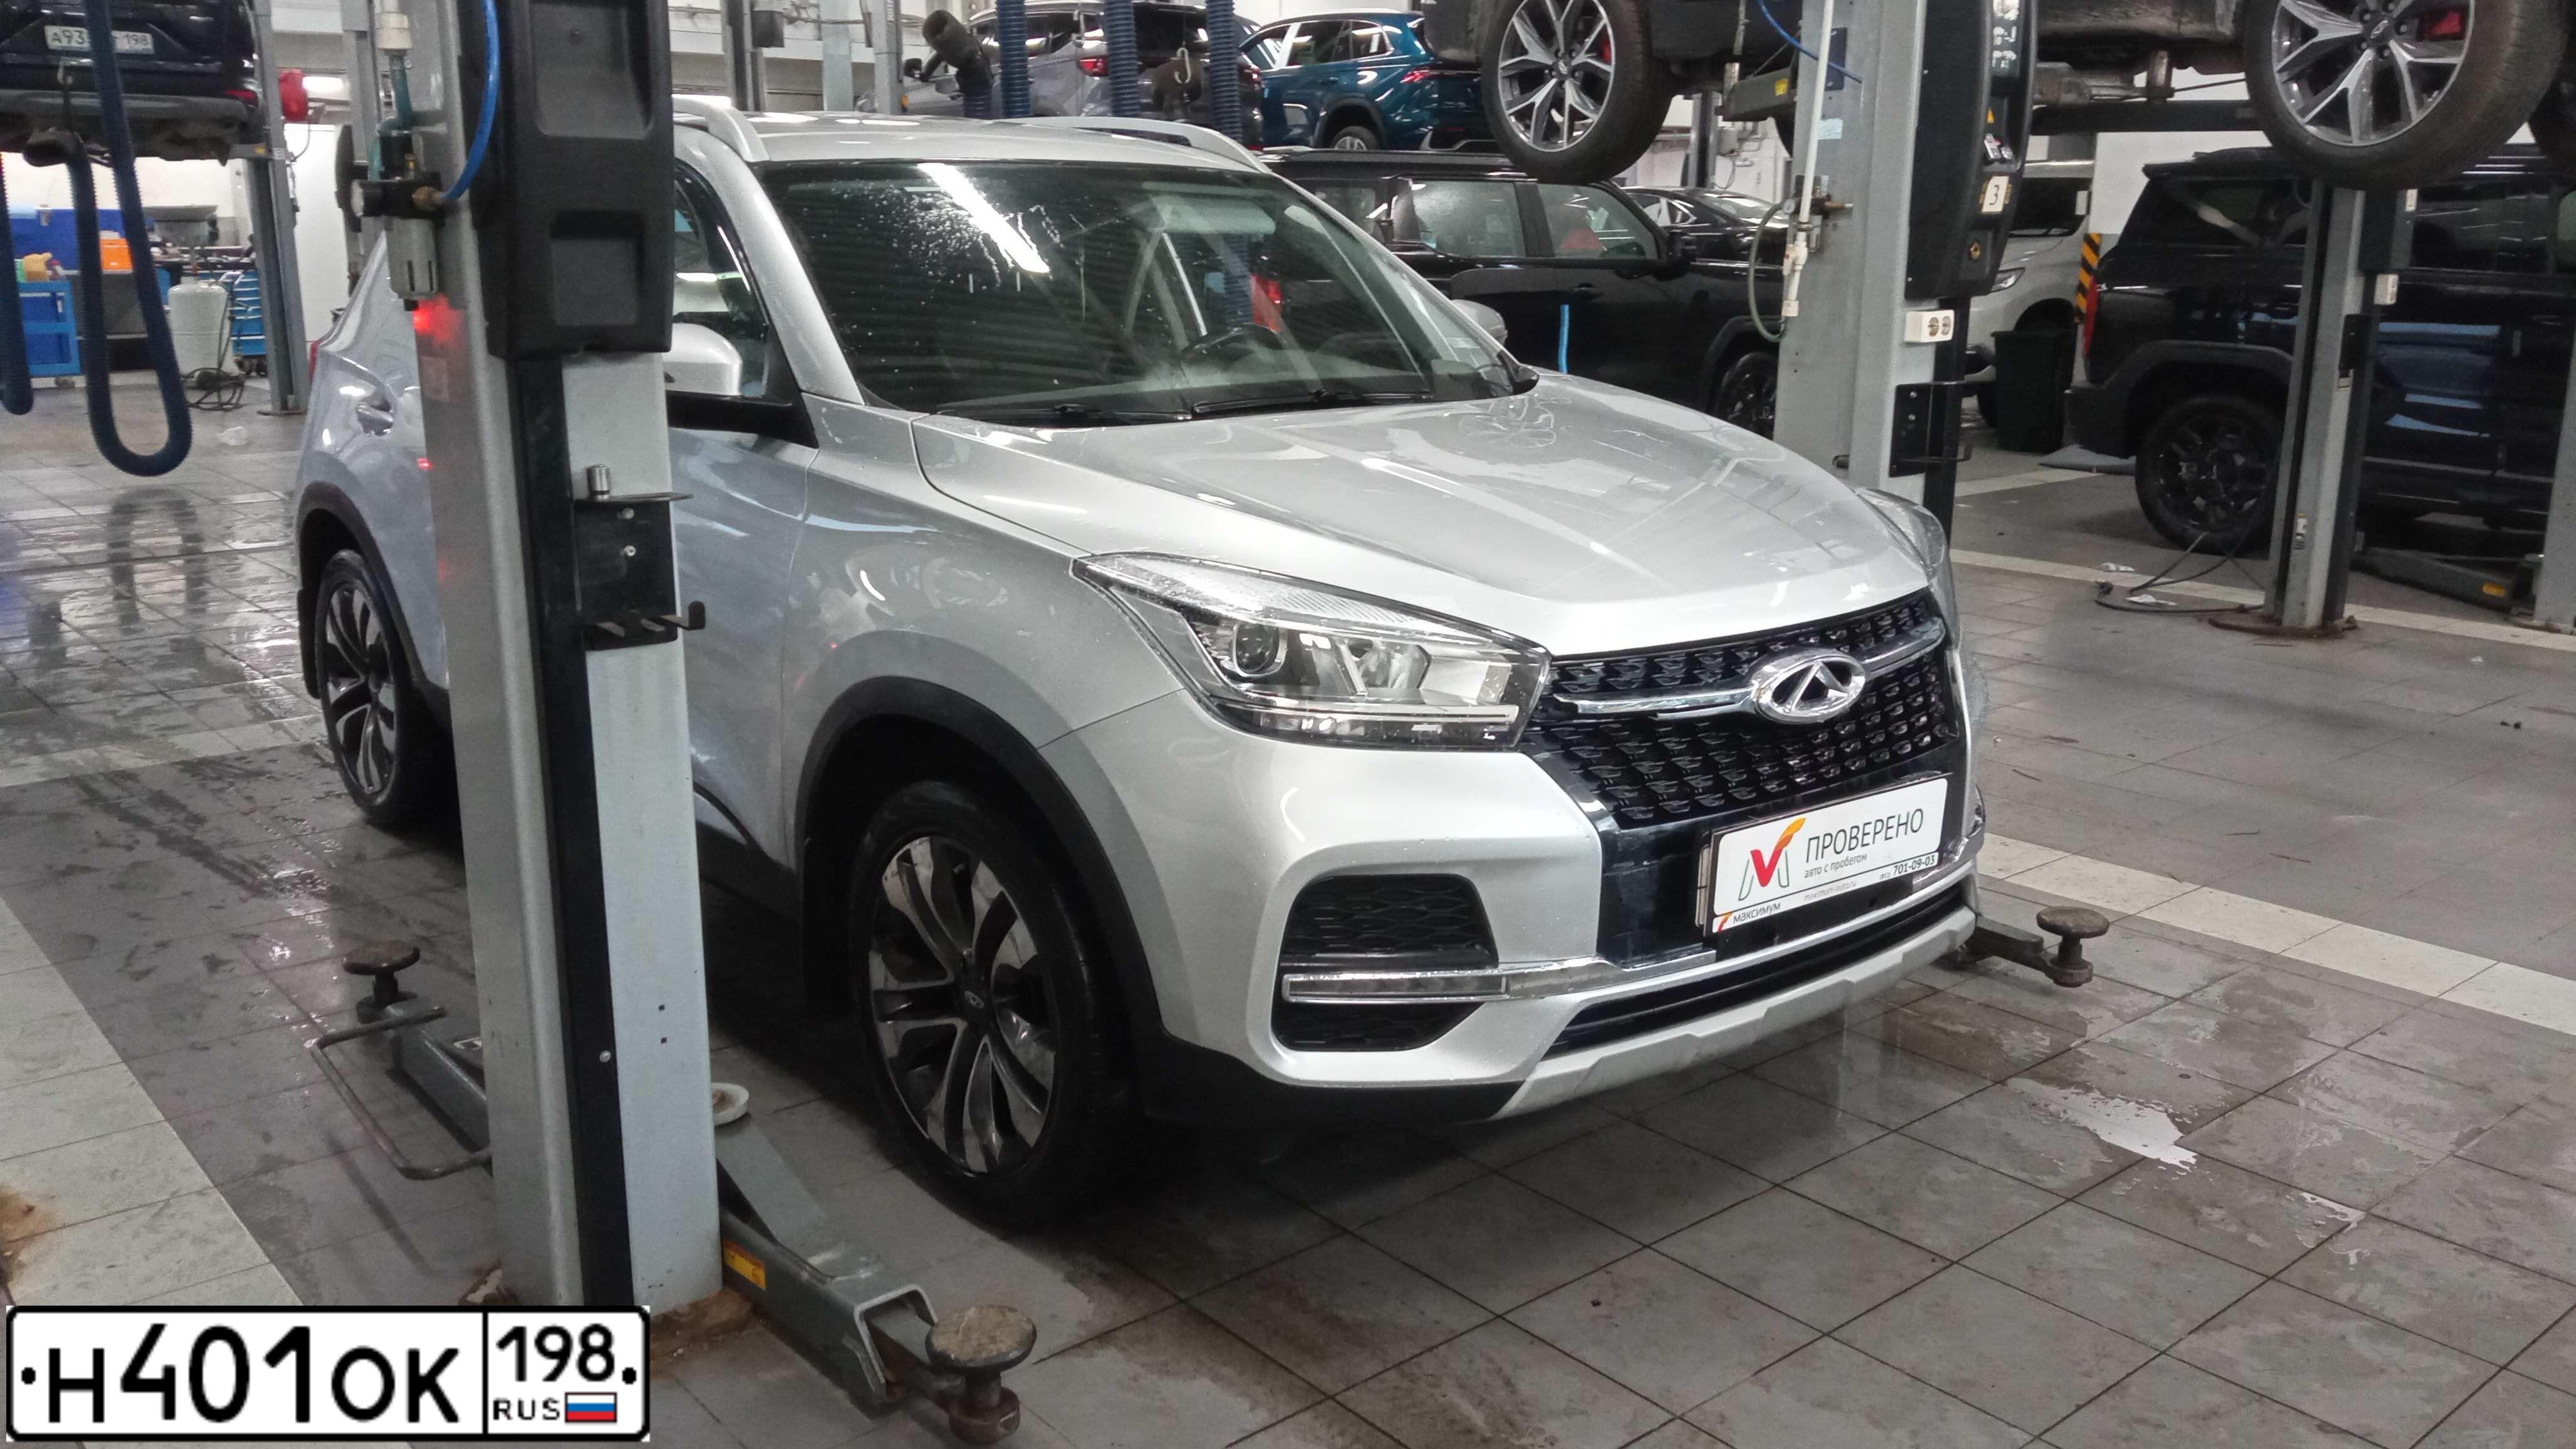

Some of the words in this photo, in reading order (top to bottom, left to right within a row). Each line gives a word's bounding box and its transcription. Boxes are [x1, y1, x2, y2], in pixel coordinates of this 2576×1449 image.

[1989, 184, 1999, 206] 3
[1806, 808, 1923, 863] ПРОВЕРЕНО
[1804, 867, 1822, 879] авто
[1830, 853, 1867, 871] пробегом
[1893, 855, 1935, 876] 701-09-03
[1733, 902, 1781, 924] максимум
